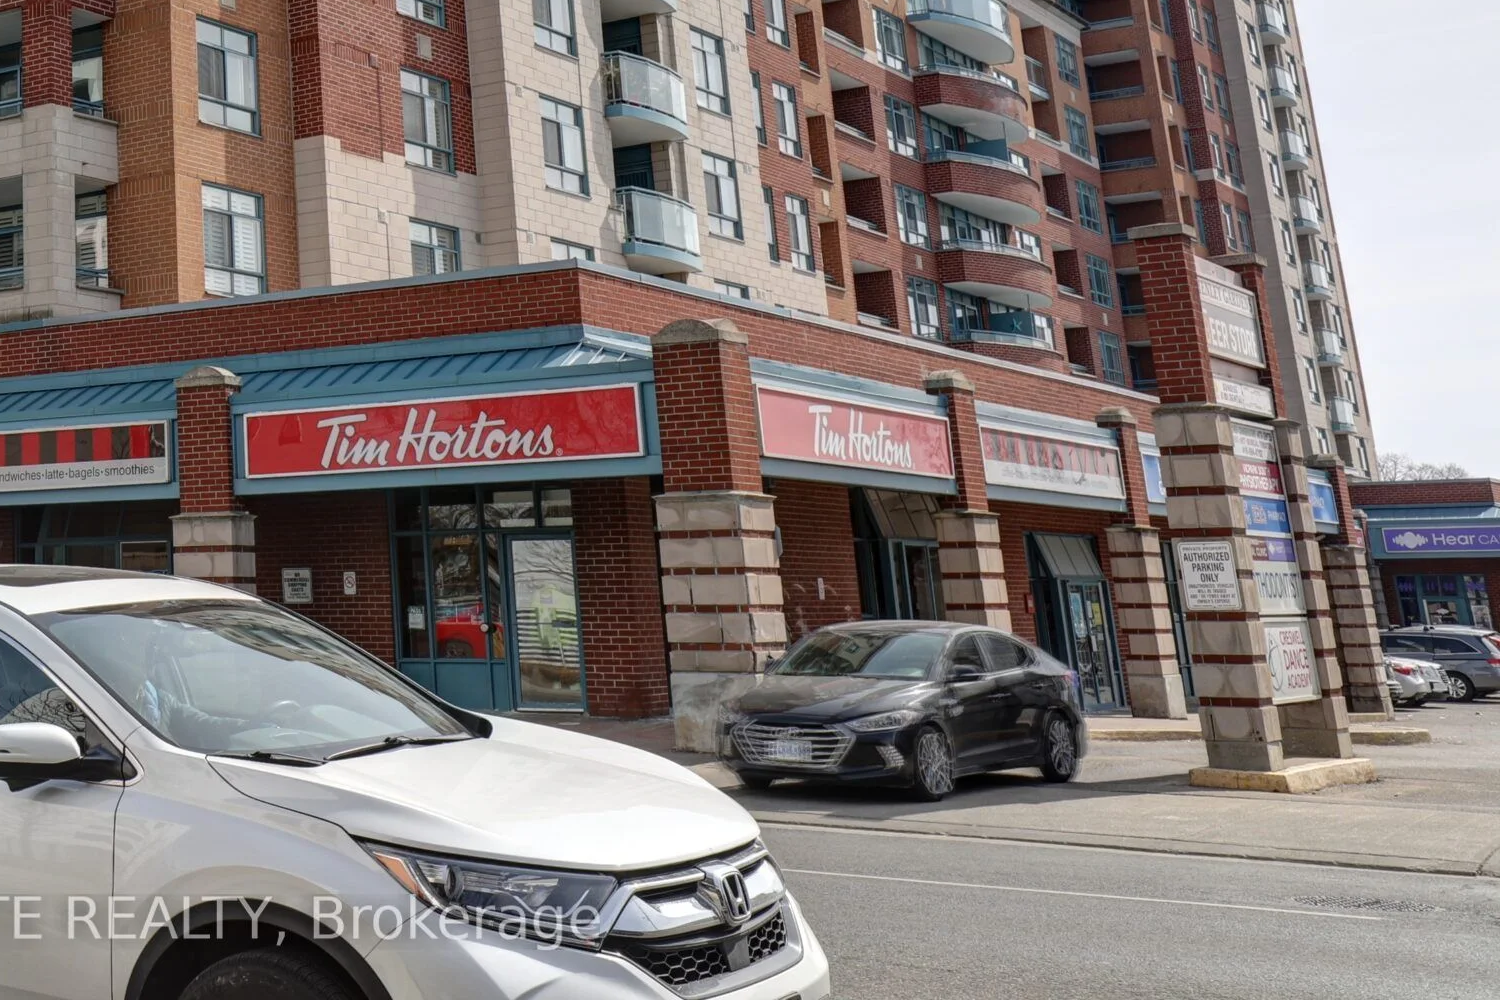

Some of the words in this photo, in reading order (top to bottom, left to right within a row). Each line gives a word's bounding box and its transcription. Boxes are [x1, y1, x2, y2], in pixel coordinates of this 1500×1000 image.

[317, 413, 388, 470] Tim
[396, 407, 556, 463] Hortons
[808, 405, 846, 461] Tim
[849, 408, 913, 469] Hortons
[45, 470, 65, 480] latte
[68, 466, 101, 480] bagels
[104, 464, 155, 477] smoothies
[1432, 532, 1476, 546] Hear
[1478, 534, 1500, 545] CA
[1183, 551, 1230, 562] AUTHORIZED
[1191, 562, 1225, 572] PARKING
[1200, 573, 1219, 582] ONLY
[1253, 571, 1300, 599] THODONTIST
[1282, 648, 1310, 671] DANCE
[1287, 672, 1313, 689] ACADEMY
